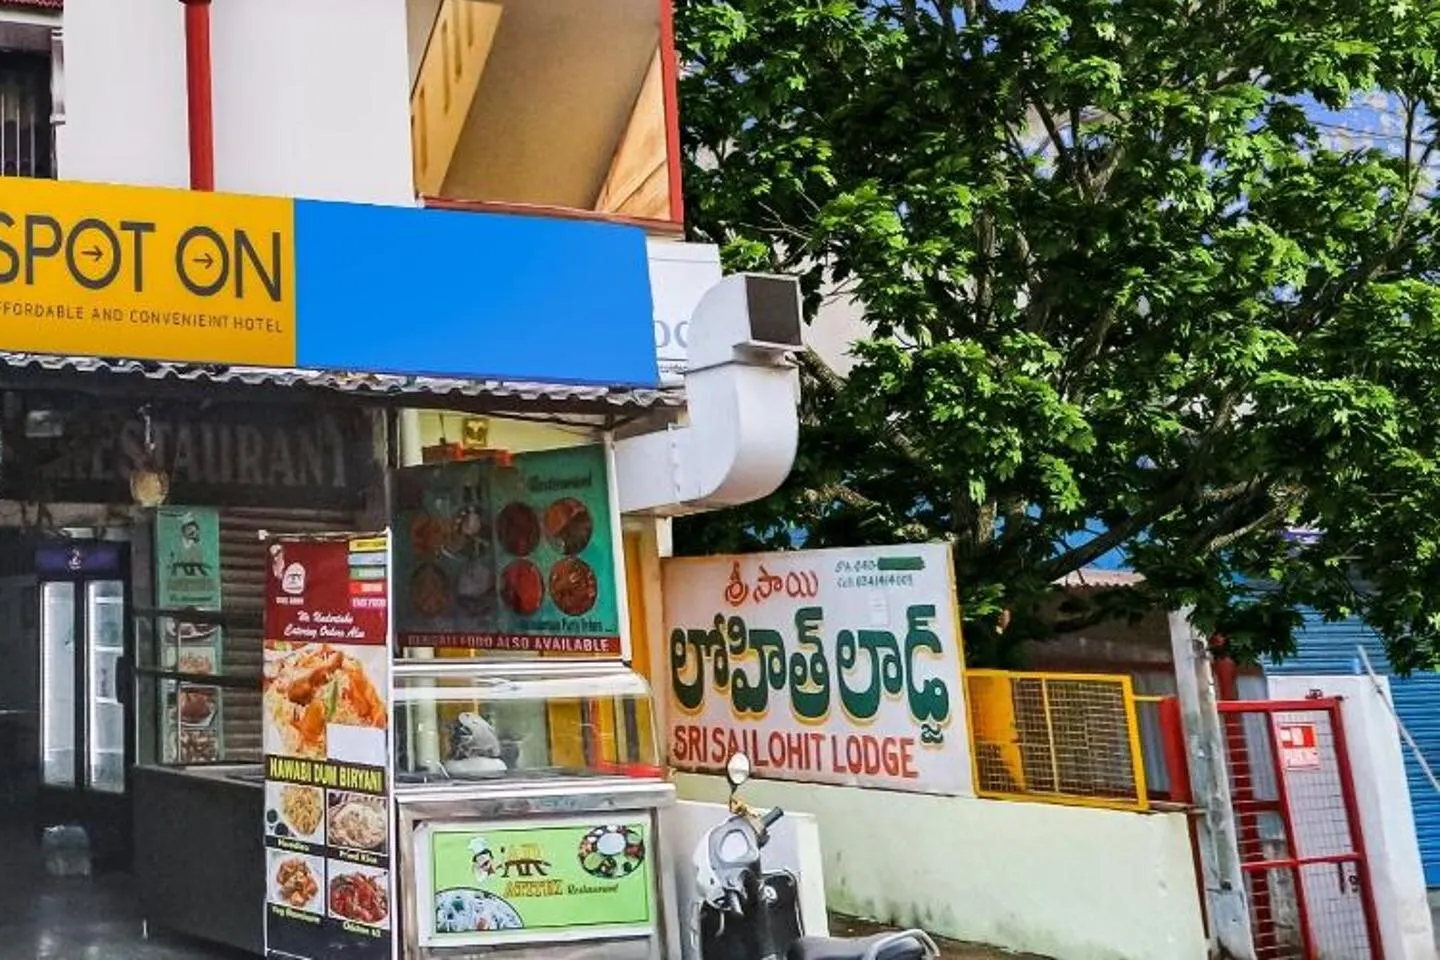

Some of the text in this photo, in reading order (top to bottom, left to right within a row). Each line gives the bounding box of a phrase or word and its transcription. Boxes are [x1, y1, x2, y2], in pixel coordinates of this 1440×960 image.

[176, 226, 282, 302] ON
[92, 307, 123, 321] AND
[234, 315, 283, 333] HOTEL
[497, 636, 531, 650] ALSO
[534, 637, 610, 653] AVAILABLE
[673, 725, 920, 779] SRI SAI LOHIT LODGE
[270, 758, 312, 782] NAWABI
[339, 767, 383, 792] BIRYANI
